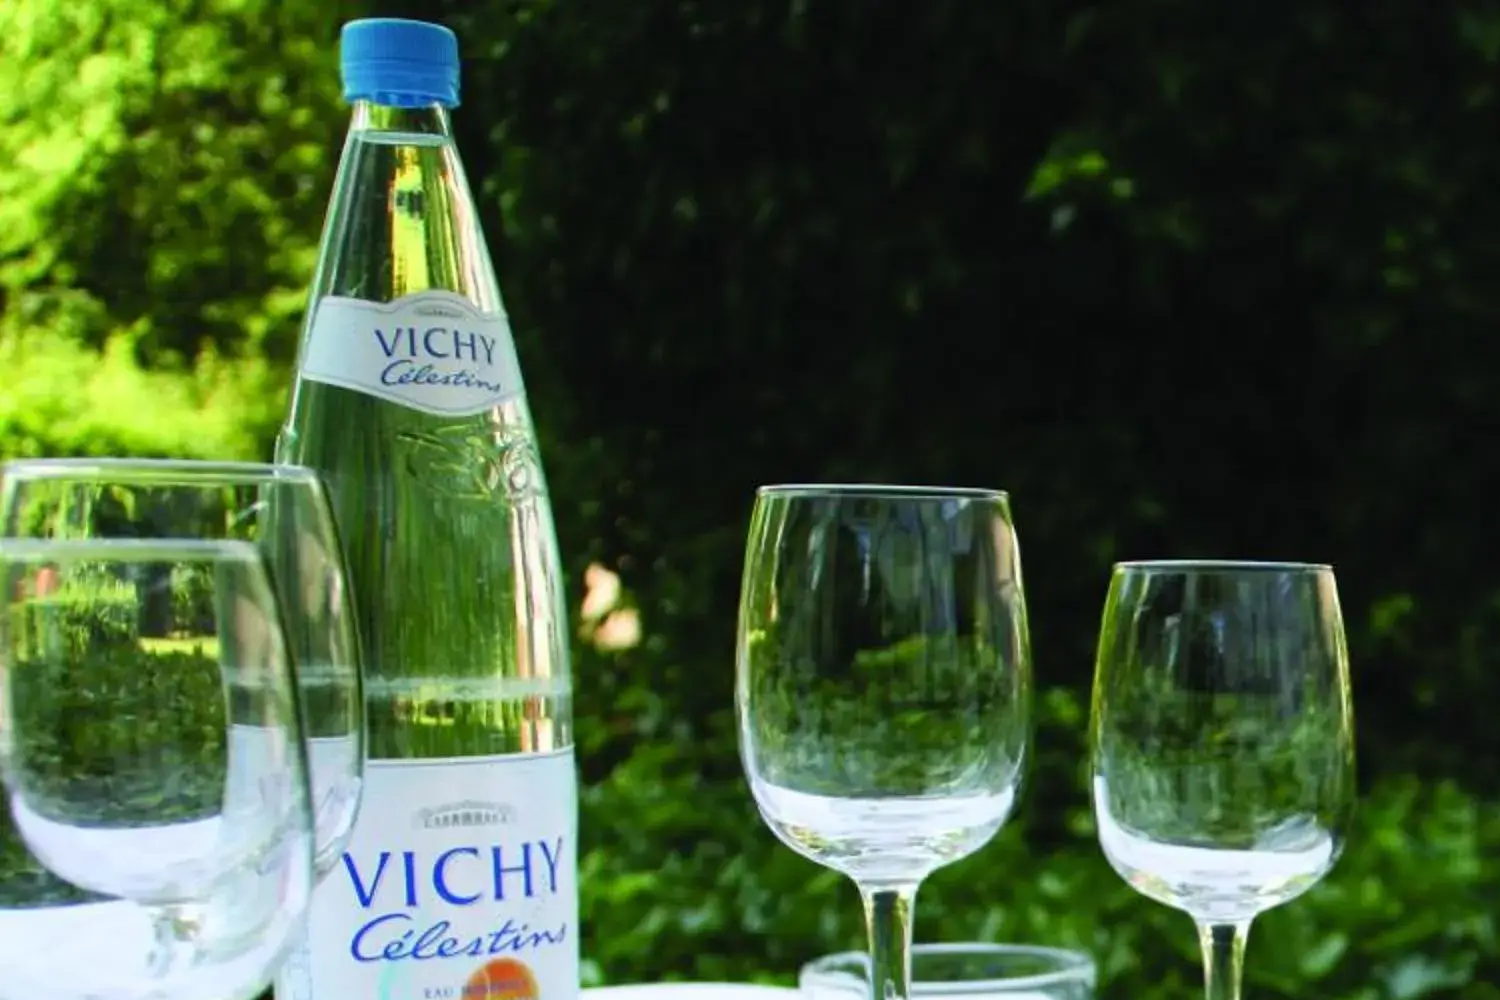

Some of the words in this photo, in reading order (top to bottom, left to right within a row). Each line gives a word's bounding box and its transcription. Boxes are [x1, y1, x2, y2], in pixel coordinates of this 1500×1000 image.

[374, 327, 496, 365] VICHY
[380, 359, 501, 393] Célestins
[342, 837, 564, 909] VICHY
[350, 913, 566, 963] Célestins
